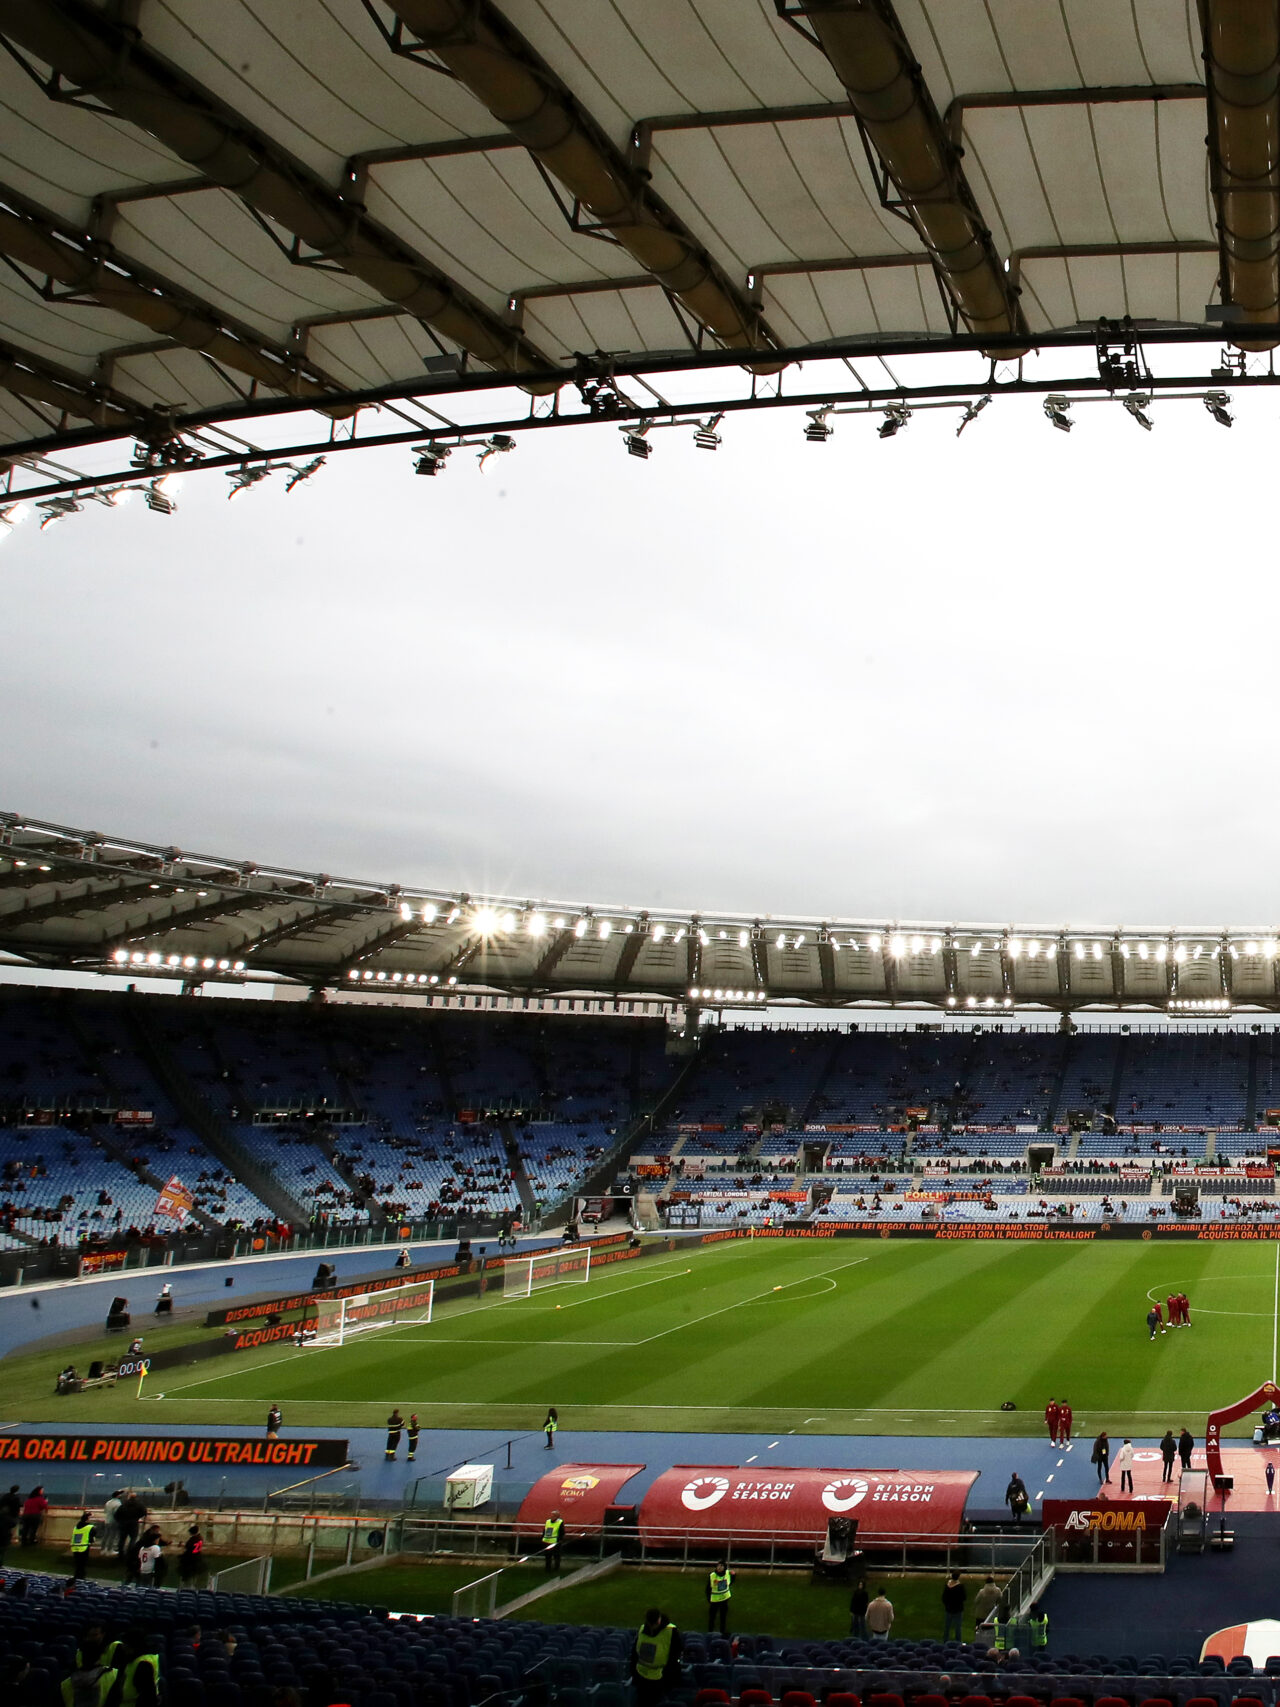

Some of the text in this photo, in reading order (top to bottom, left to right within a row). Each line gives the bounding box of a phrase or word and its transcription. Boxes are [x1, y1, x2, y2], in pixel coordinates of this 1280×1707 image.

[622, 1185, 631, 1194] C
[725, 1230, 737, 1240] ORA
[737, 1229, 745, 1238] IL
[785, 1229, 837, 1238] ULTRALIGHT
[935, 1231, 1097, 1239] ACQUISTA ORA IL PIUMINO ULTRALIGHT
[1197, 1231, 1239, 1240] ACQUISTA
[1241, 1231, 1258, 1239] ORA
[1260, 1231, 1268, 1239] IL
[526, 1264, 556, 1281] ACQUIST
[606, 1247, 642, 1263] ULTRALIGHT
[225, 1300, 285, 1323] DISPONIBILE
[286, 1297, 301, 1311] NEI
[337, 1283, 366, 1299] ONLINE
[373, 1280, 385, 1292] SU
[416, 1269, 438, 1284] BRAND
[439, 1265, 461, 1278] STORE
[379, 1291, 436, 1315] ULTRALIGH
[119, 1358, 151, 1376] 00:00
[23, 1439, 67, 1460] ORA
[70, 1439, 89, 1460] IL
[91, 1440, 185, 1462] PIUMINO
[187, 1441, 318, 1465] ULTRALIGHT
[736, 1482, 796, 1490] RIYADH
[875, 1484, 935, 1492] RIYADH
[559, 1489, 585, 1497] ROMA
[731, 1491, 791, 1500] SEASON
[872, 1493, 932, 1502] SEASON
